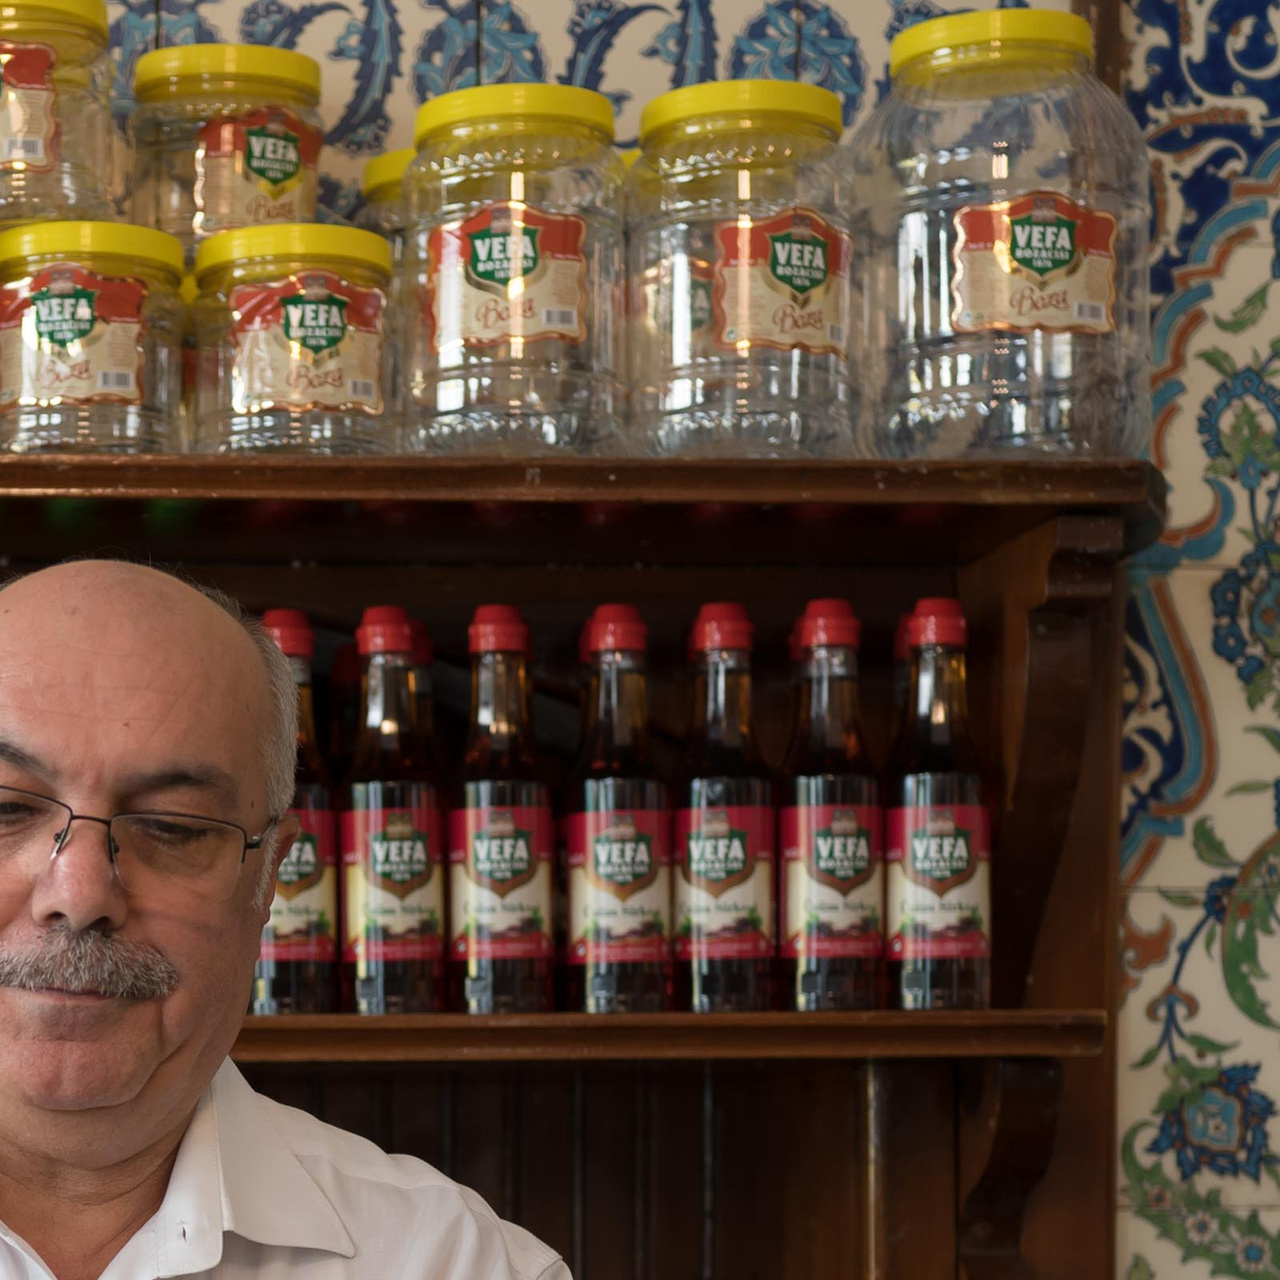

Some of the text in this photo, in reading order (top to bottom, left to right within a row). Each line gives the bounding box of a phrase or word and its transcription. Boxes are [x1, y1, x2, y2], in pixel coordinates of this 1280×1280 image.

[248, 135, 299, 163] VEFA
[1014, 225, 1072, 250] VEFA
[774, 242, 826, 269] VEFA
[35, 298, 92, 321] VEFA
[1009, 286, 1071, 315] Boza
[286, 303, 343, 327] VEFA
[772, 303, 825, 333] Boza
[286, 364, 344, 391] Boza
[372, 840, 427, 862] VEFA
[474, 838, 530, 861] VEFA
[595, 842, 651, 864] VEFA
[689, 839, 745, 861] VEFA
[817, 837, 870, 858] VEFA
[913, 837, 968, 859] VEFA
